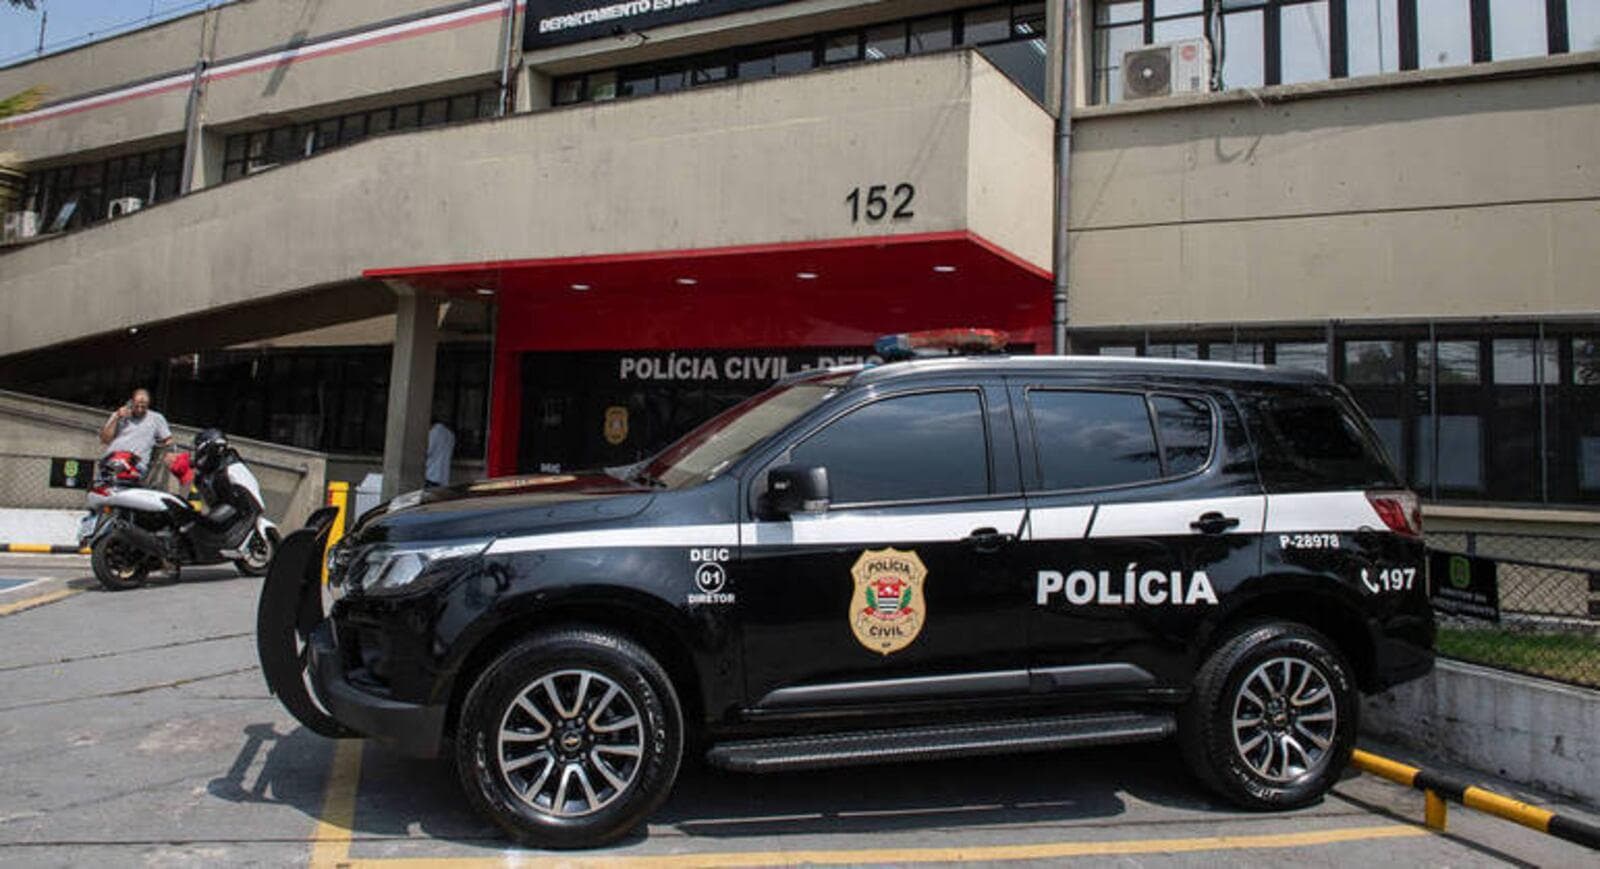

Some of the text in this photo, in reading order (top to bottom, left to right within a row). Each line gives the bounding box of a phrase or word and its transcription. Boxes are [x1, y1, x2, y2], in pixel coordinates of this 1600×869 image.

[845, 183, 915, 223] 152
[620, 352, 719, 380] POLÍCIA
[724, 356, 789, 380] CIVIL
[1279, 534, 1340, 549] P-28978
[690, 548, 729, 561] DEIC
[701, 570, 720, 585] 01
[1036, 562, 1219, 605] POLÍCIA
[1379, 568, 1417, 591] 197
[688, 593, 736, 604] DIRETOR
[869, 625, 904, 637] CIVIL
